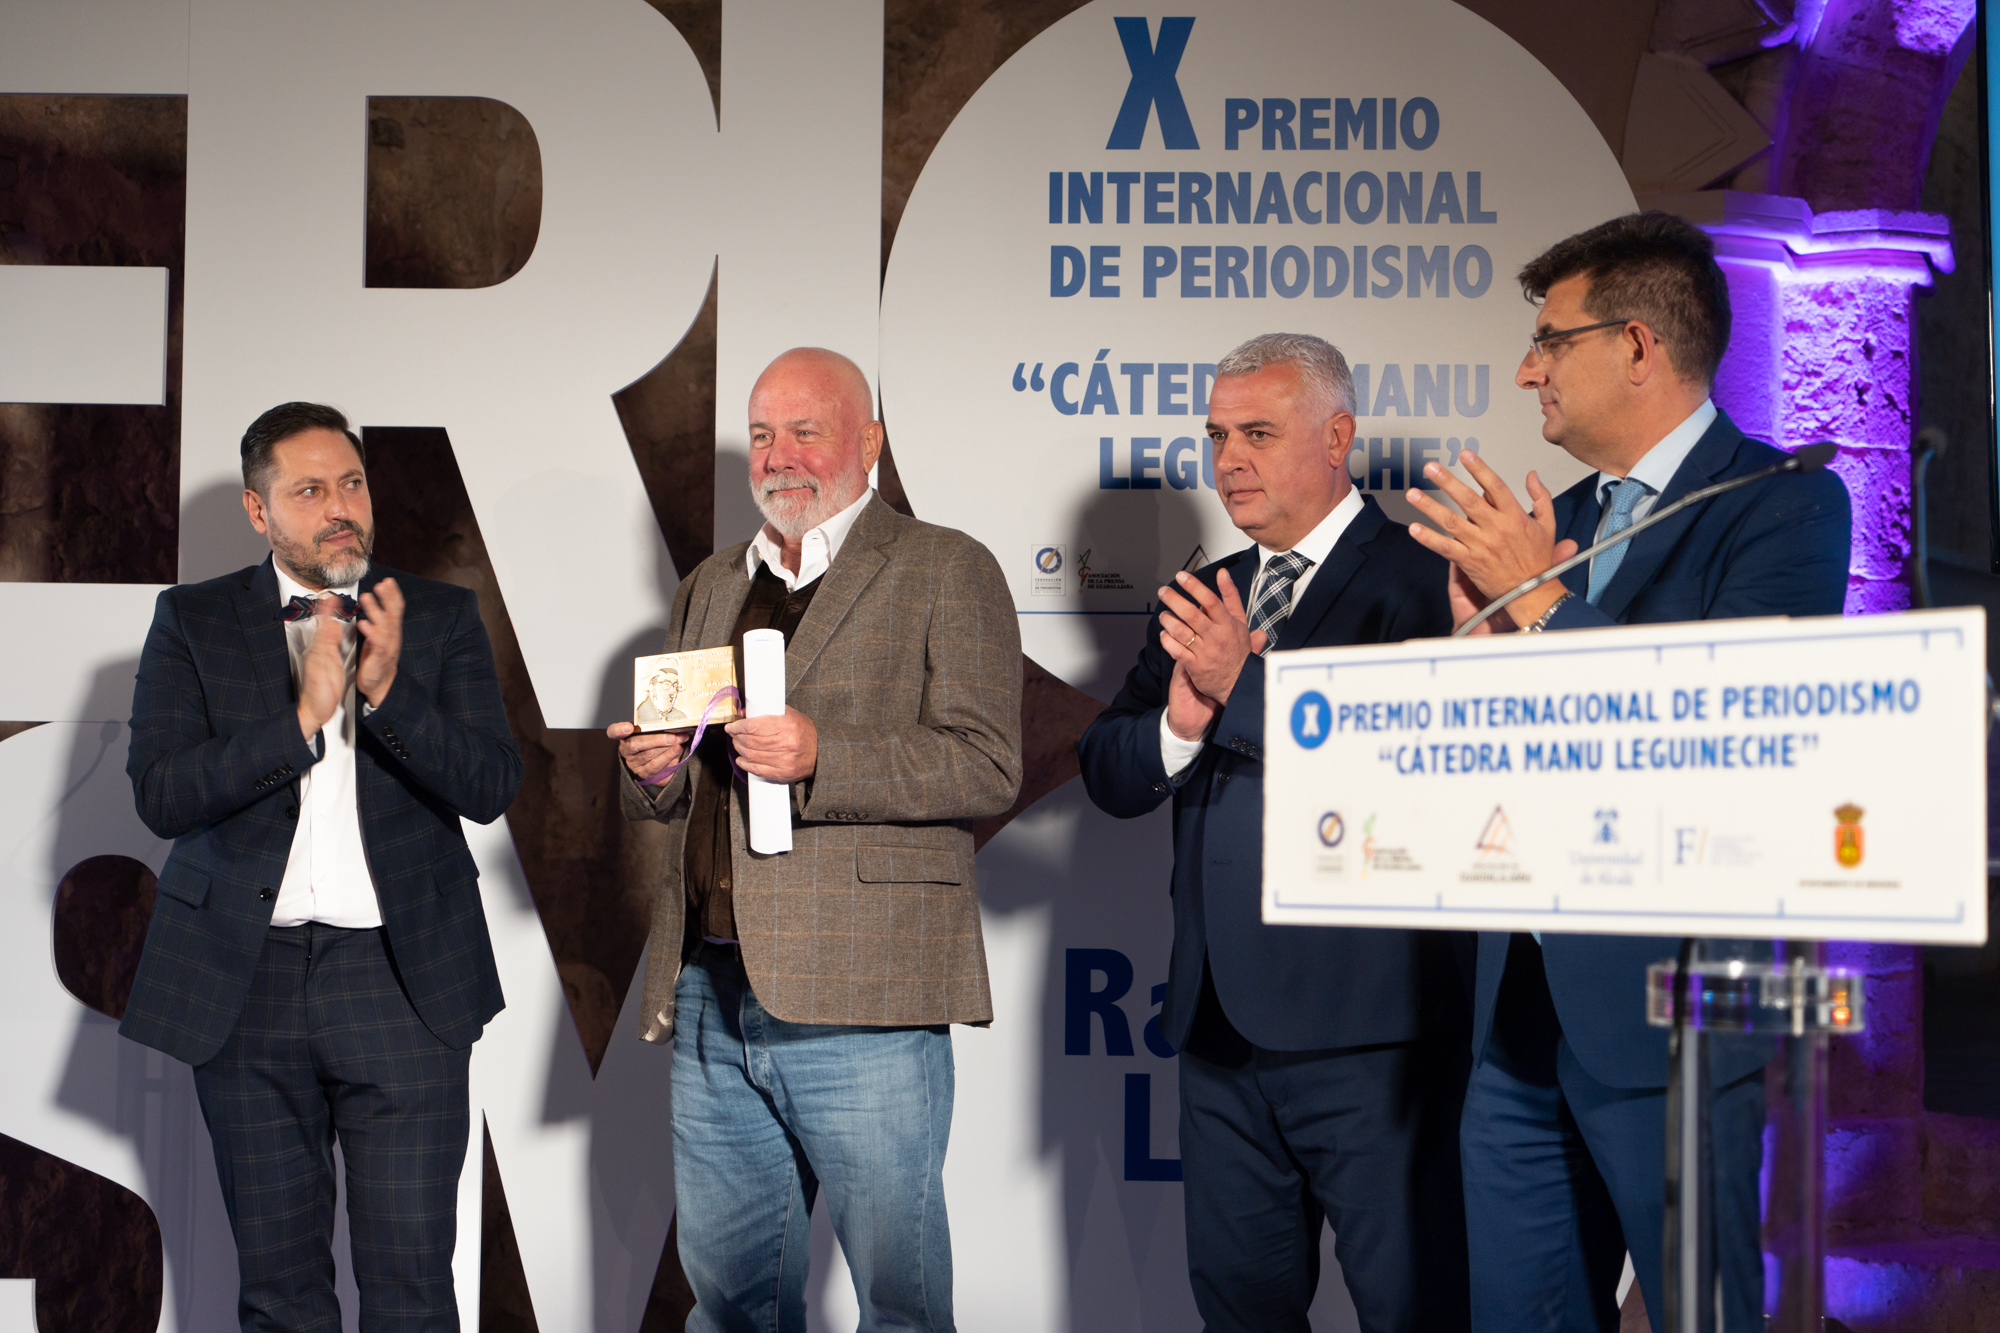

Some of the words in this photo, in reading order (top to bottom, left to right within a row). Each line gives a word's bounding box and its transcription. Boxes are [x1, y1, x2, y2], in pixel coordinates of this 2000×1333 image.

[1105, 16, 1200, 150] X
[1225, 97, 1440, 151] PREMIO
[1049, 171, 1497, 225] INTERNACIONAL
[1050, 245, 1121, 298] DE
[1143, 244, 1493, 299] PERIODISMO
[1012, 348, 1216, 416] “CÁTED
[1301, 702, 1322, 738] X
[1338, 699, 1432, 733] PREMIO
[1442, 690, 1660, 729] INTERNACIONAL
[1673, 688, 1709, 721] DE
[1722, 678, 1921, 720] PERIODISMO
[1378, 735, 1513, 775] “CÁTEDRA
[1524, 738, 1604, 773] MANU
[1615, 732, 1820, 771] LEGUINECHE”
